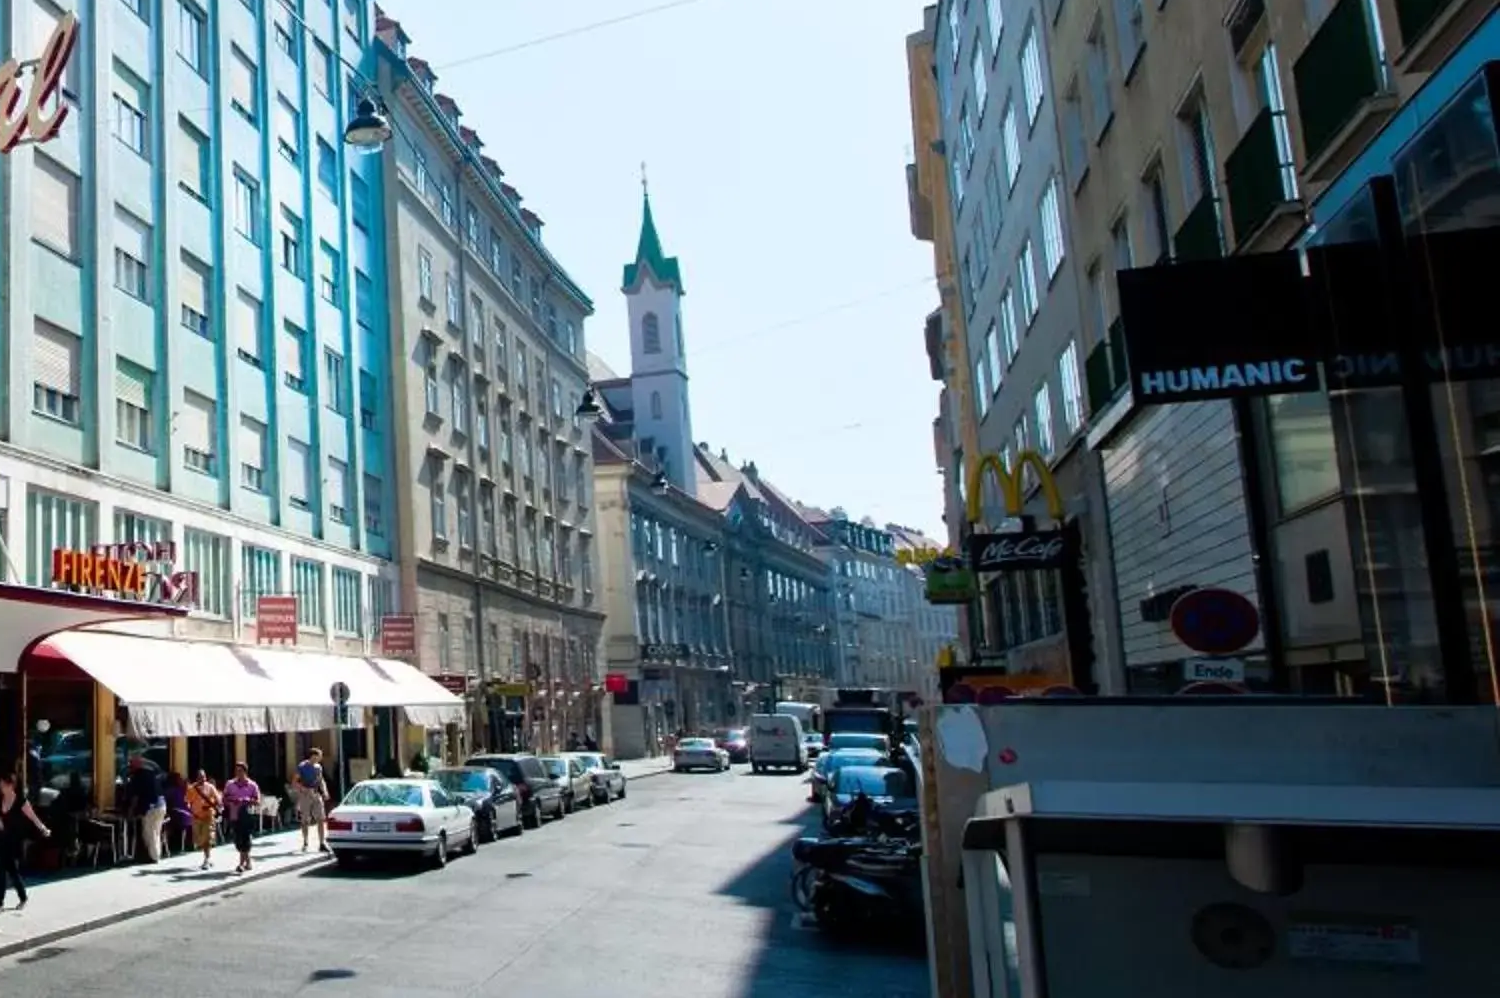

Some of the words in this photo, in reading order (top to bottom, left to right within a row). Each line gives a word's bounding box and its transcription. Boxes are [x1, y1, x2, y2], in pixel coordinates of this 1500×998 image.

[1141, 358, 1307, 395] HUMANIC
[54, 547, 147, 595] FIRENZE
[1194, 663, 1234, 680] Ende
